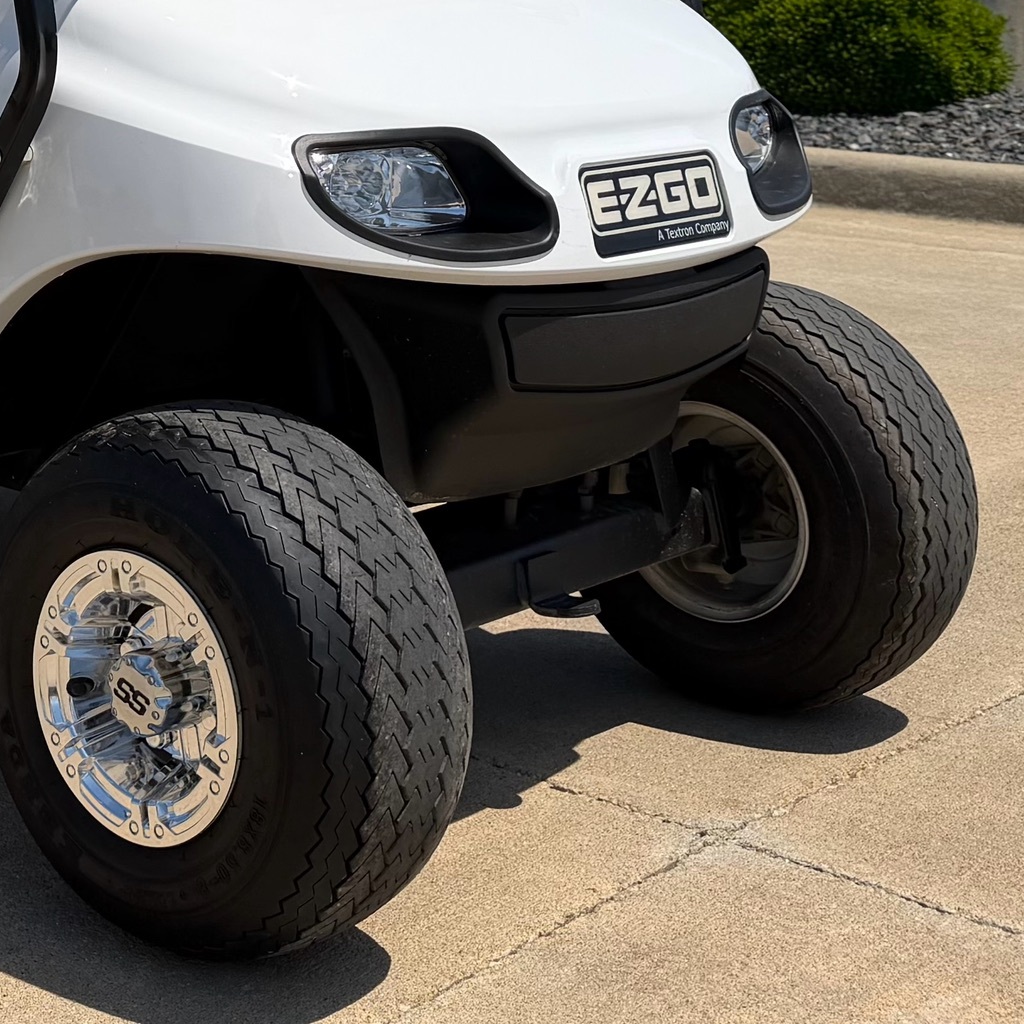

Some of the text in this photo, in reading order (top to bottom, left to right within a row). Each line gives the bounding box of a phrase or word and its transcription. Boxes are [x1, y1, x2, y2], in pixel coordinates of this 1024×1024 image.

[658, 220, 729, 242] A Textron Company
